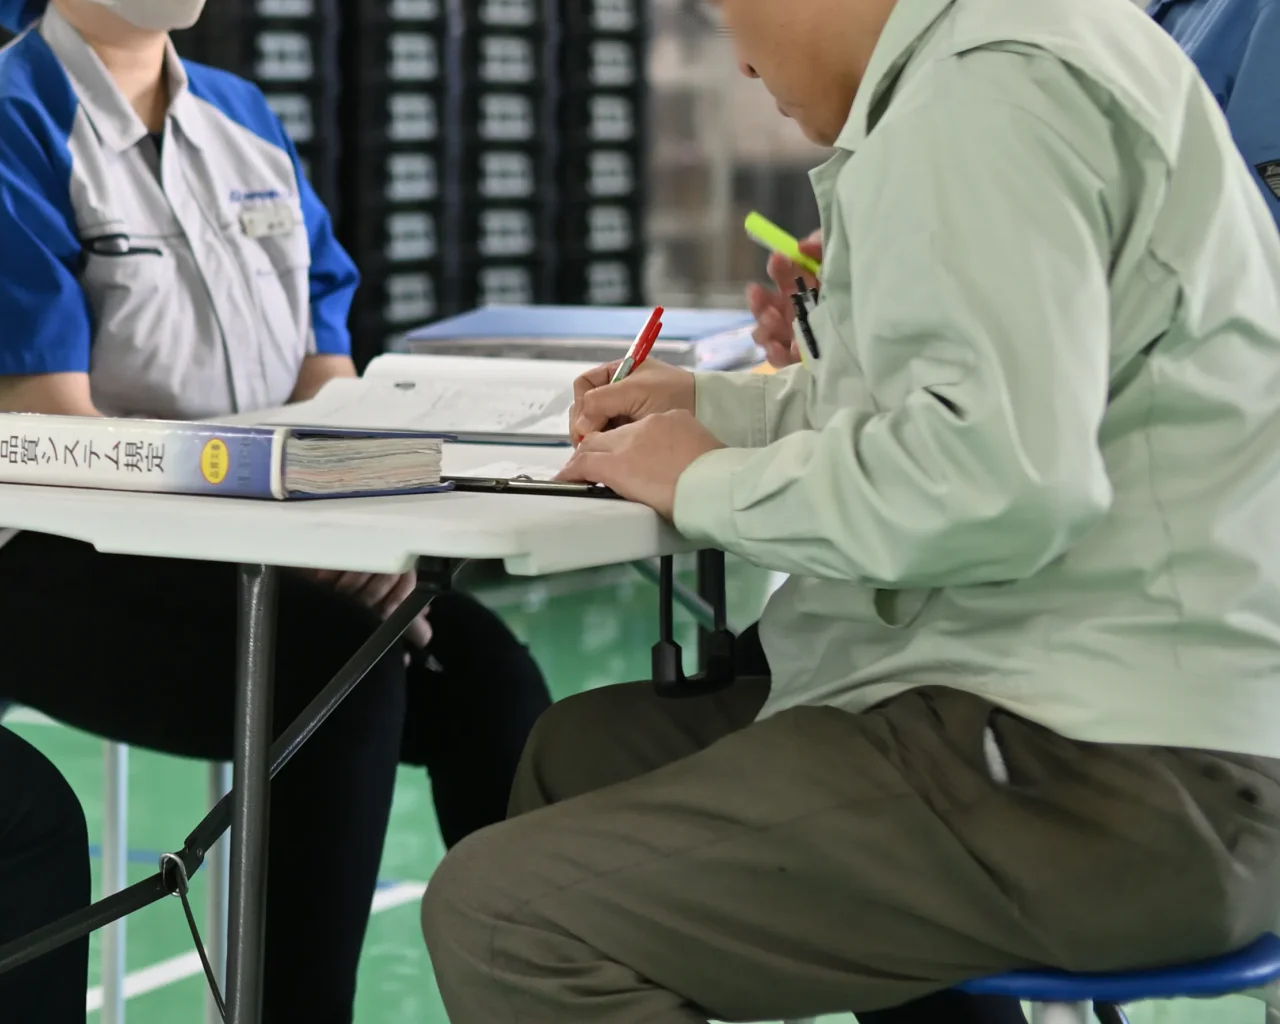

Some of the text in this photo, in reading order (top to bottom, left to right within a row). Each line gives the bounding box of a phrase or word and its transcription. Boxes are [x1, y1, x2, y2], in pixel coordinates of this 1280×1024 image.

[0, 434, 166, 474] 品質システム規定
